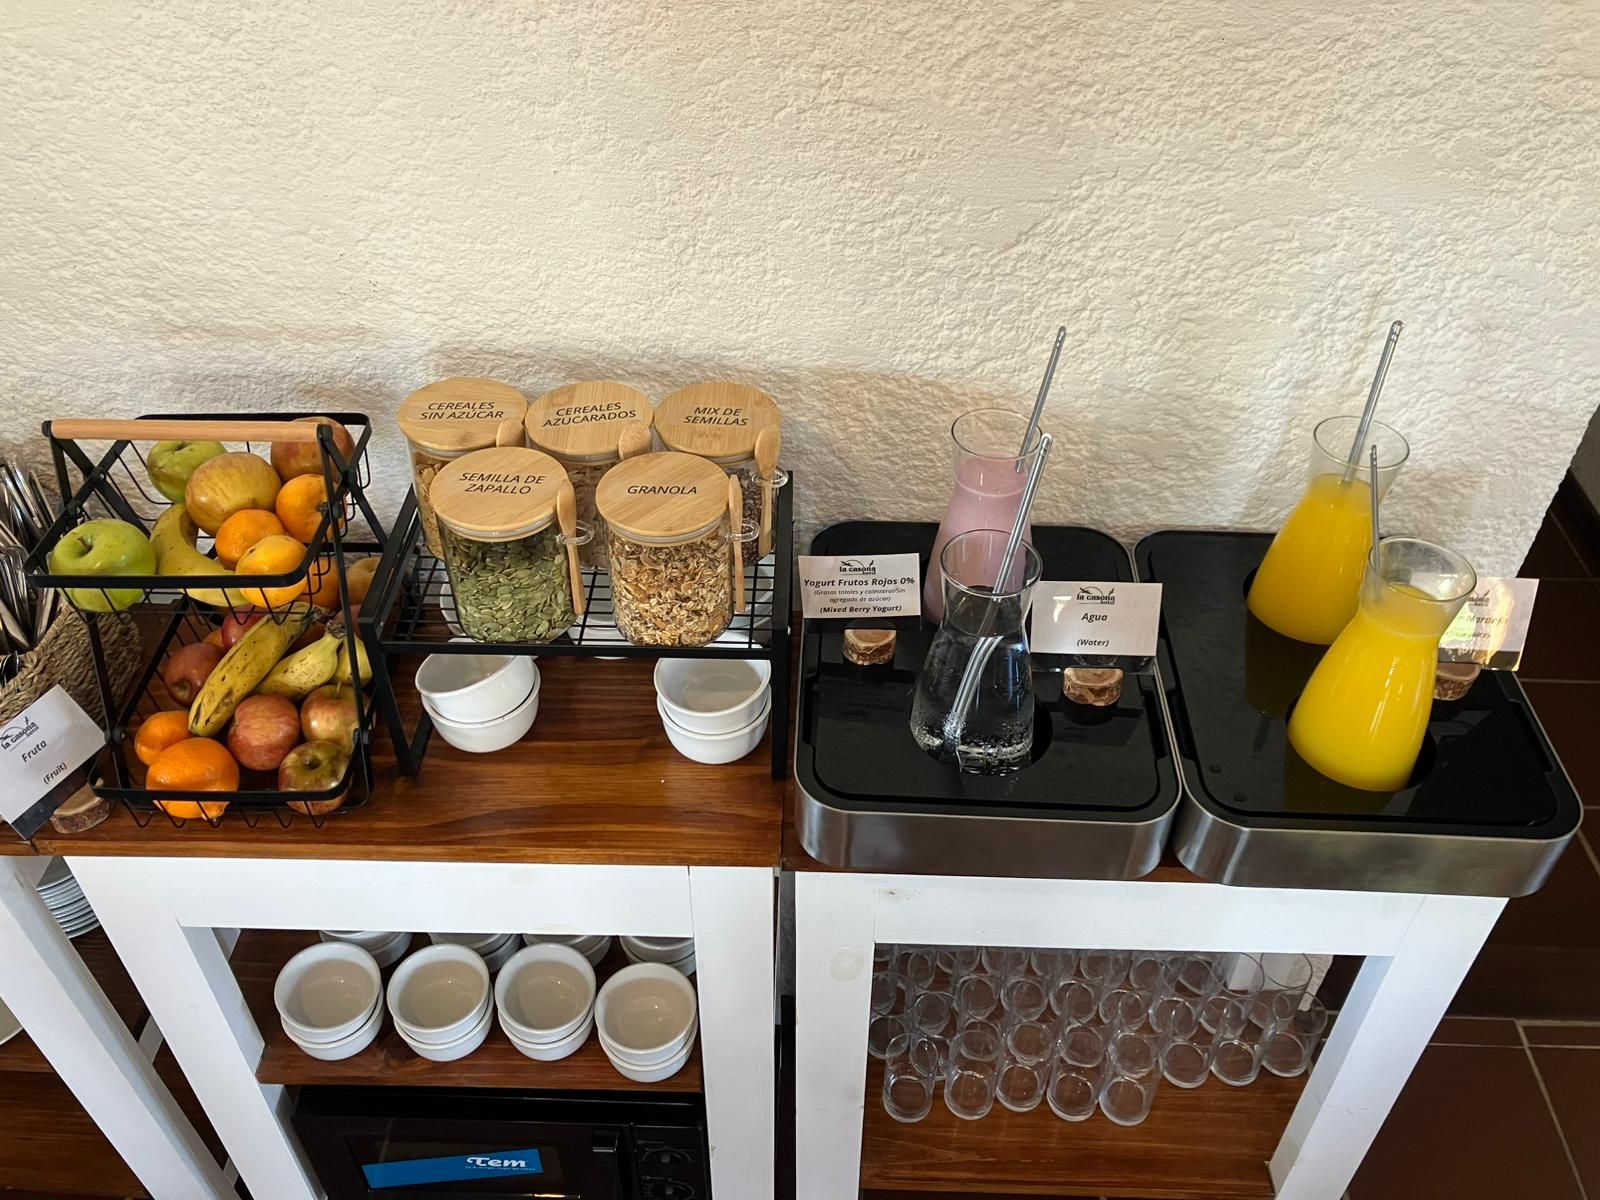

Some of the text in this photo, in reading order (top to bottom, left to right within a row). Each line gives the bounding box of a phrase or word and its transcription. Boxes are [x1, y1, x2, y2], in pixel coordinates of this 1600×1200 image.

[428, 402, 495, 410] CEREALES
[556, 402, 622, 416] CEREALES
[694, 407, 720, 415] MIX
[420, 409, 504, 419] SIN AZÚCAR
[543, 410, 636, 427] AZUCARADOS
[683, 416, 748, 426] SEMILLAS
[459, 472, 546, 484] SEMILLA DE
[465, 484, 531, 494] ZAPALLO
[627, 486, 697, 494] GRANOLA
[804, 579, 835, 588] Yogurt
[872, 578, 898, 586] Rojos
[1082, 612, 1108, 623] Agua
[1077, 639, 1109, 647] (Water)
[11, 722, 37, 743] casona
[22, 740, 47, 762] Fruta
[44, 762, 67, 784] (Fruit)
[466, 1156, 527, 1167] Tem
